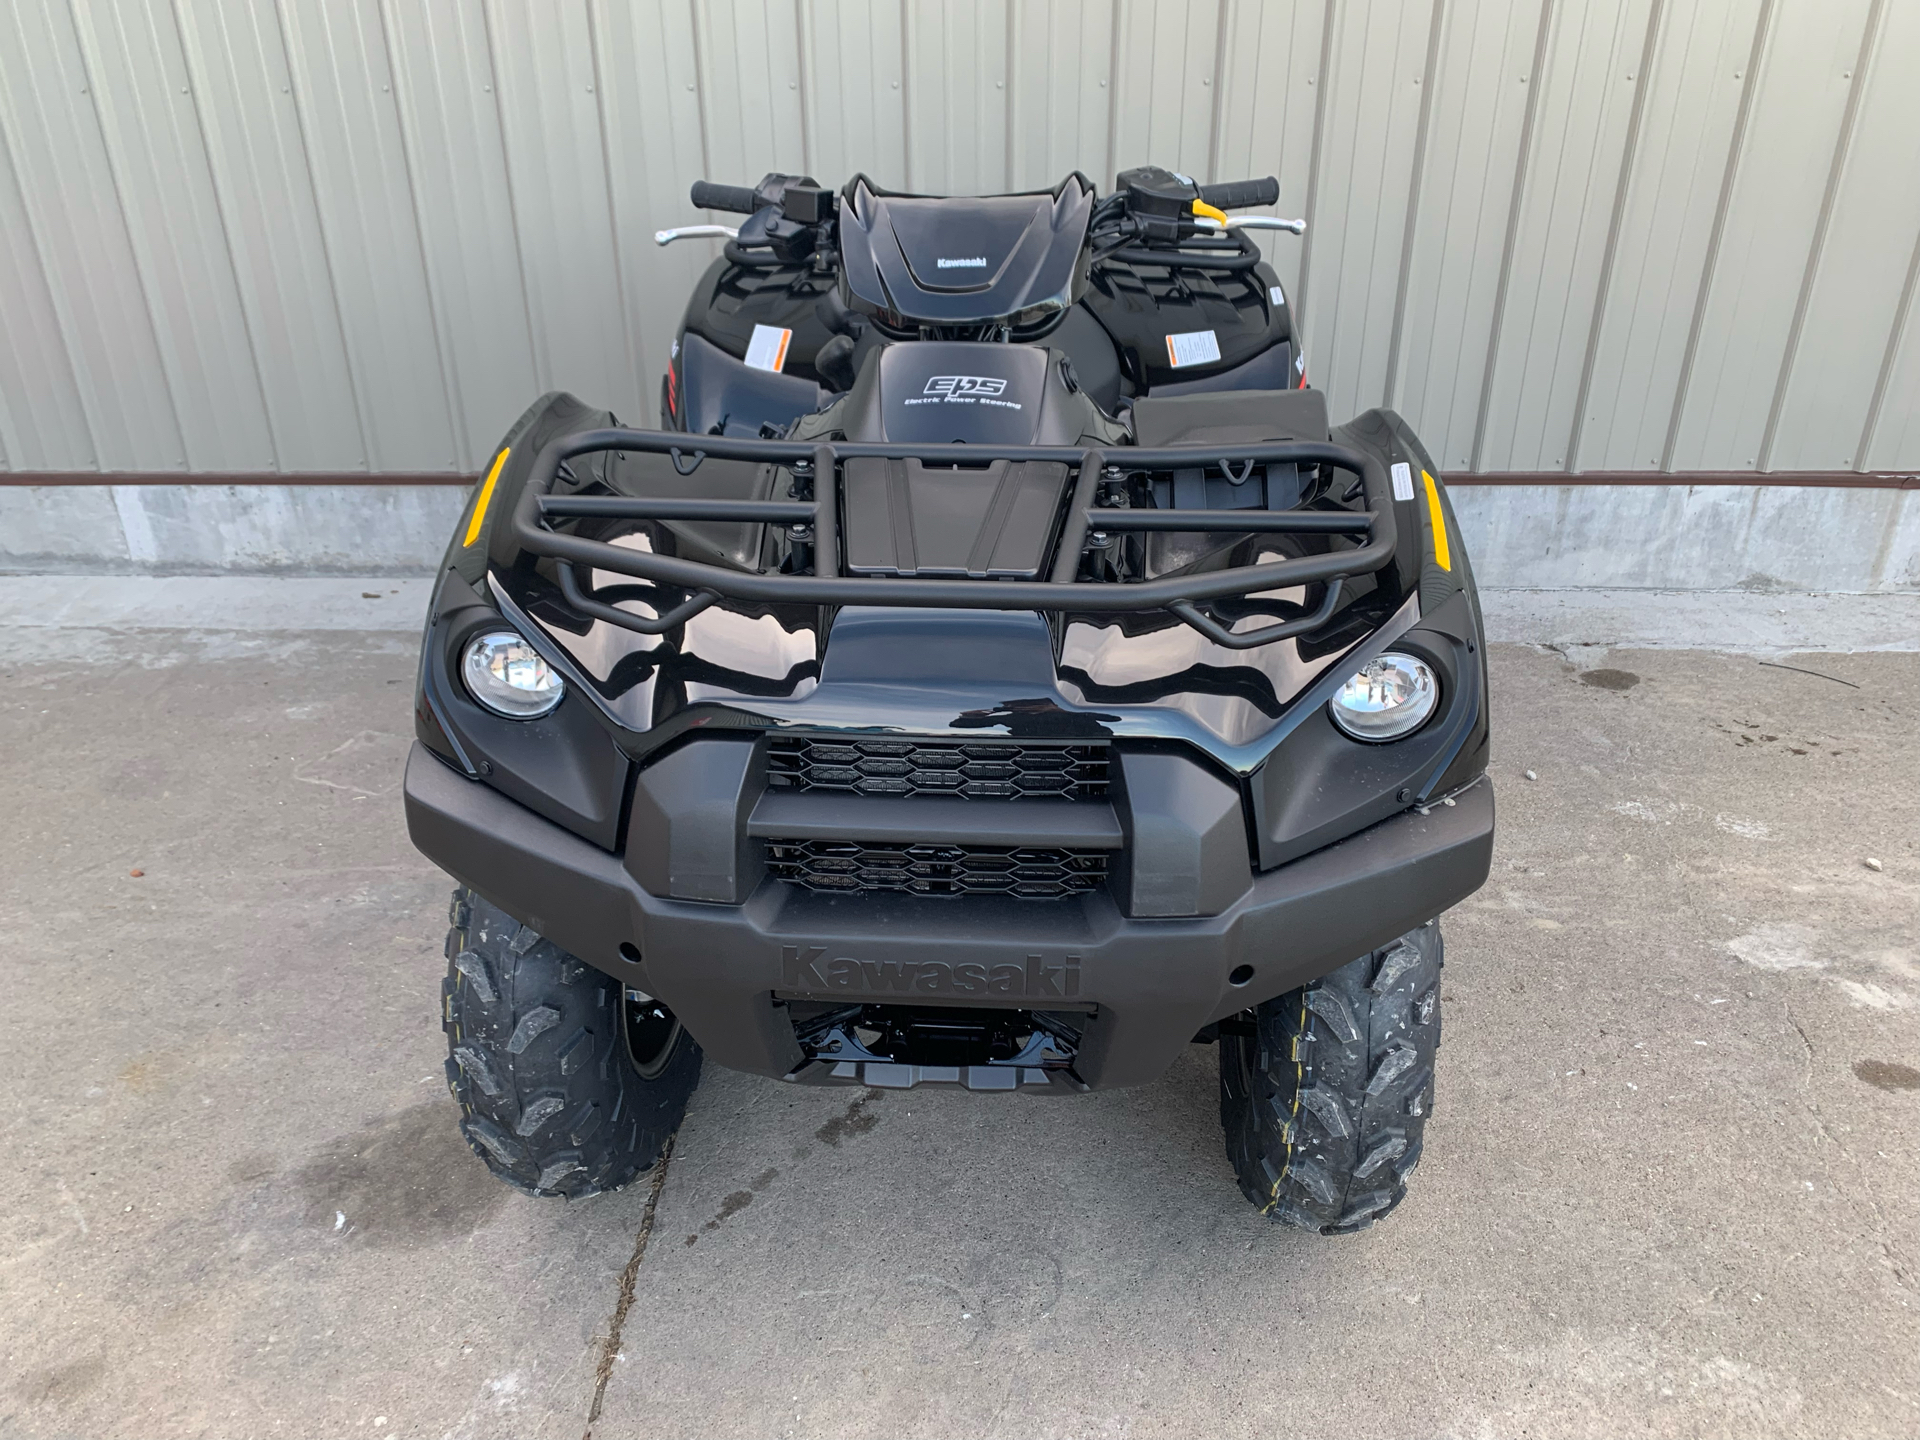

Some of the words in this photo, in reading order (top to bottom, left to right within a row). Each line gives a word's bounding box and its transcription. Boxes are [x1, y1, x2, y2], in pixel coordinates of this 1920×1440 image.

[937, 256, 987, 269] Kawasaki
[904, 396, 941, 406] Electric
[943, 396, 977, 404] Power
[979, 397, 1022, 410] Steering
[781, 945, 1082, 997] Kawasaki
